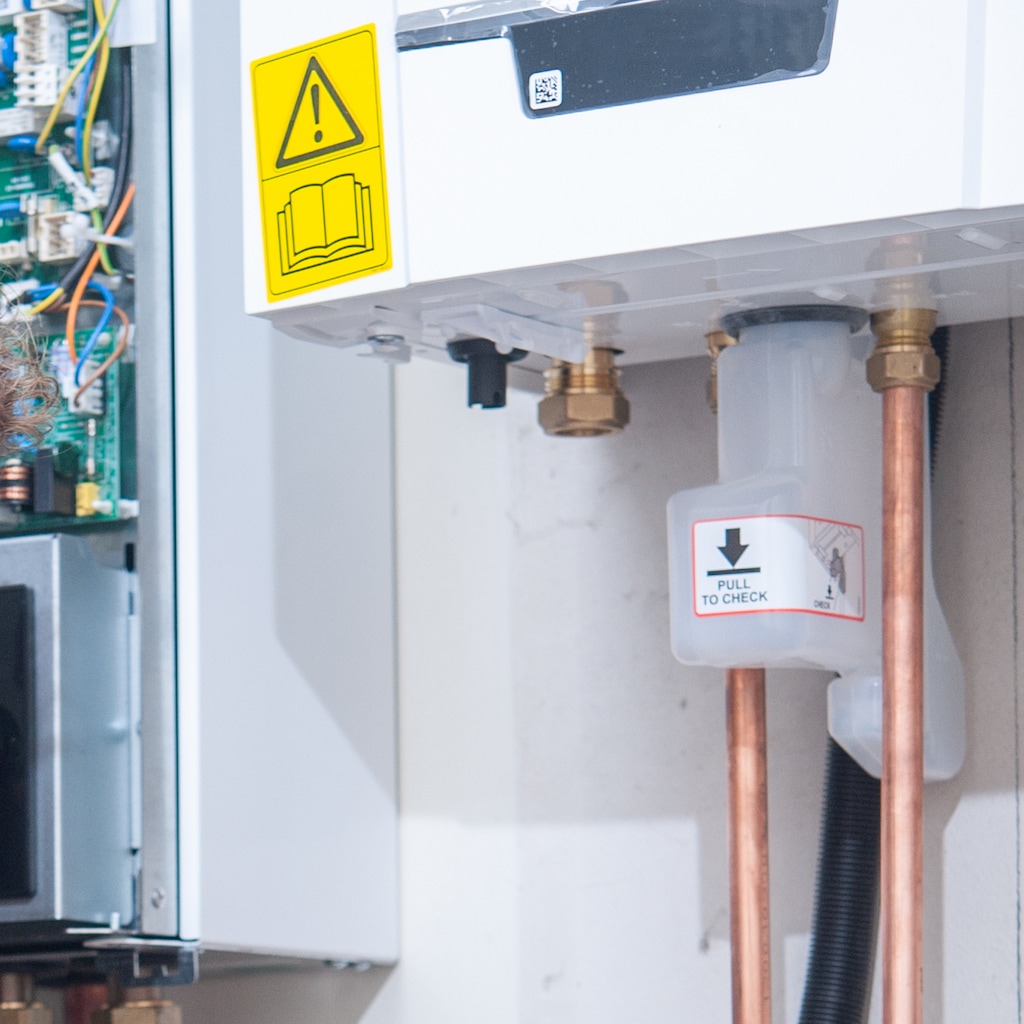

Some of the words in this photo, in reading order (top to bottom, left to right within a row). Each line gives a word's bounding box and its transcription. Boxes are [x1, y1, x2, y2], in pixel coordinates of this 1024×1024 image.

[717, 579, 751, 591] PULL
[701, 594, 719, 606] TO
[722, 591, 768, 605] CHECK
[813, 599, 831, 610] CHECK
